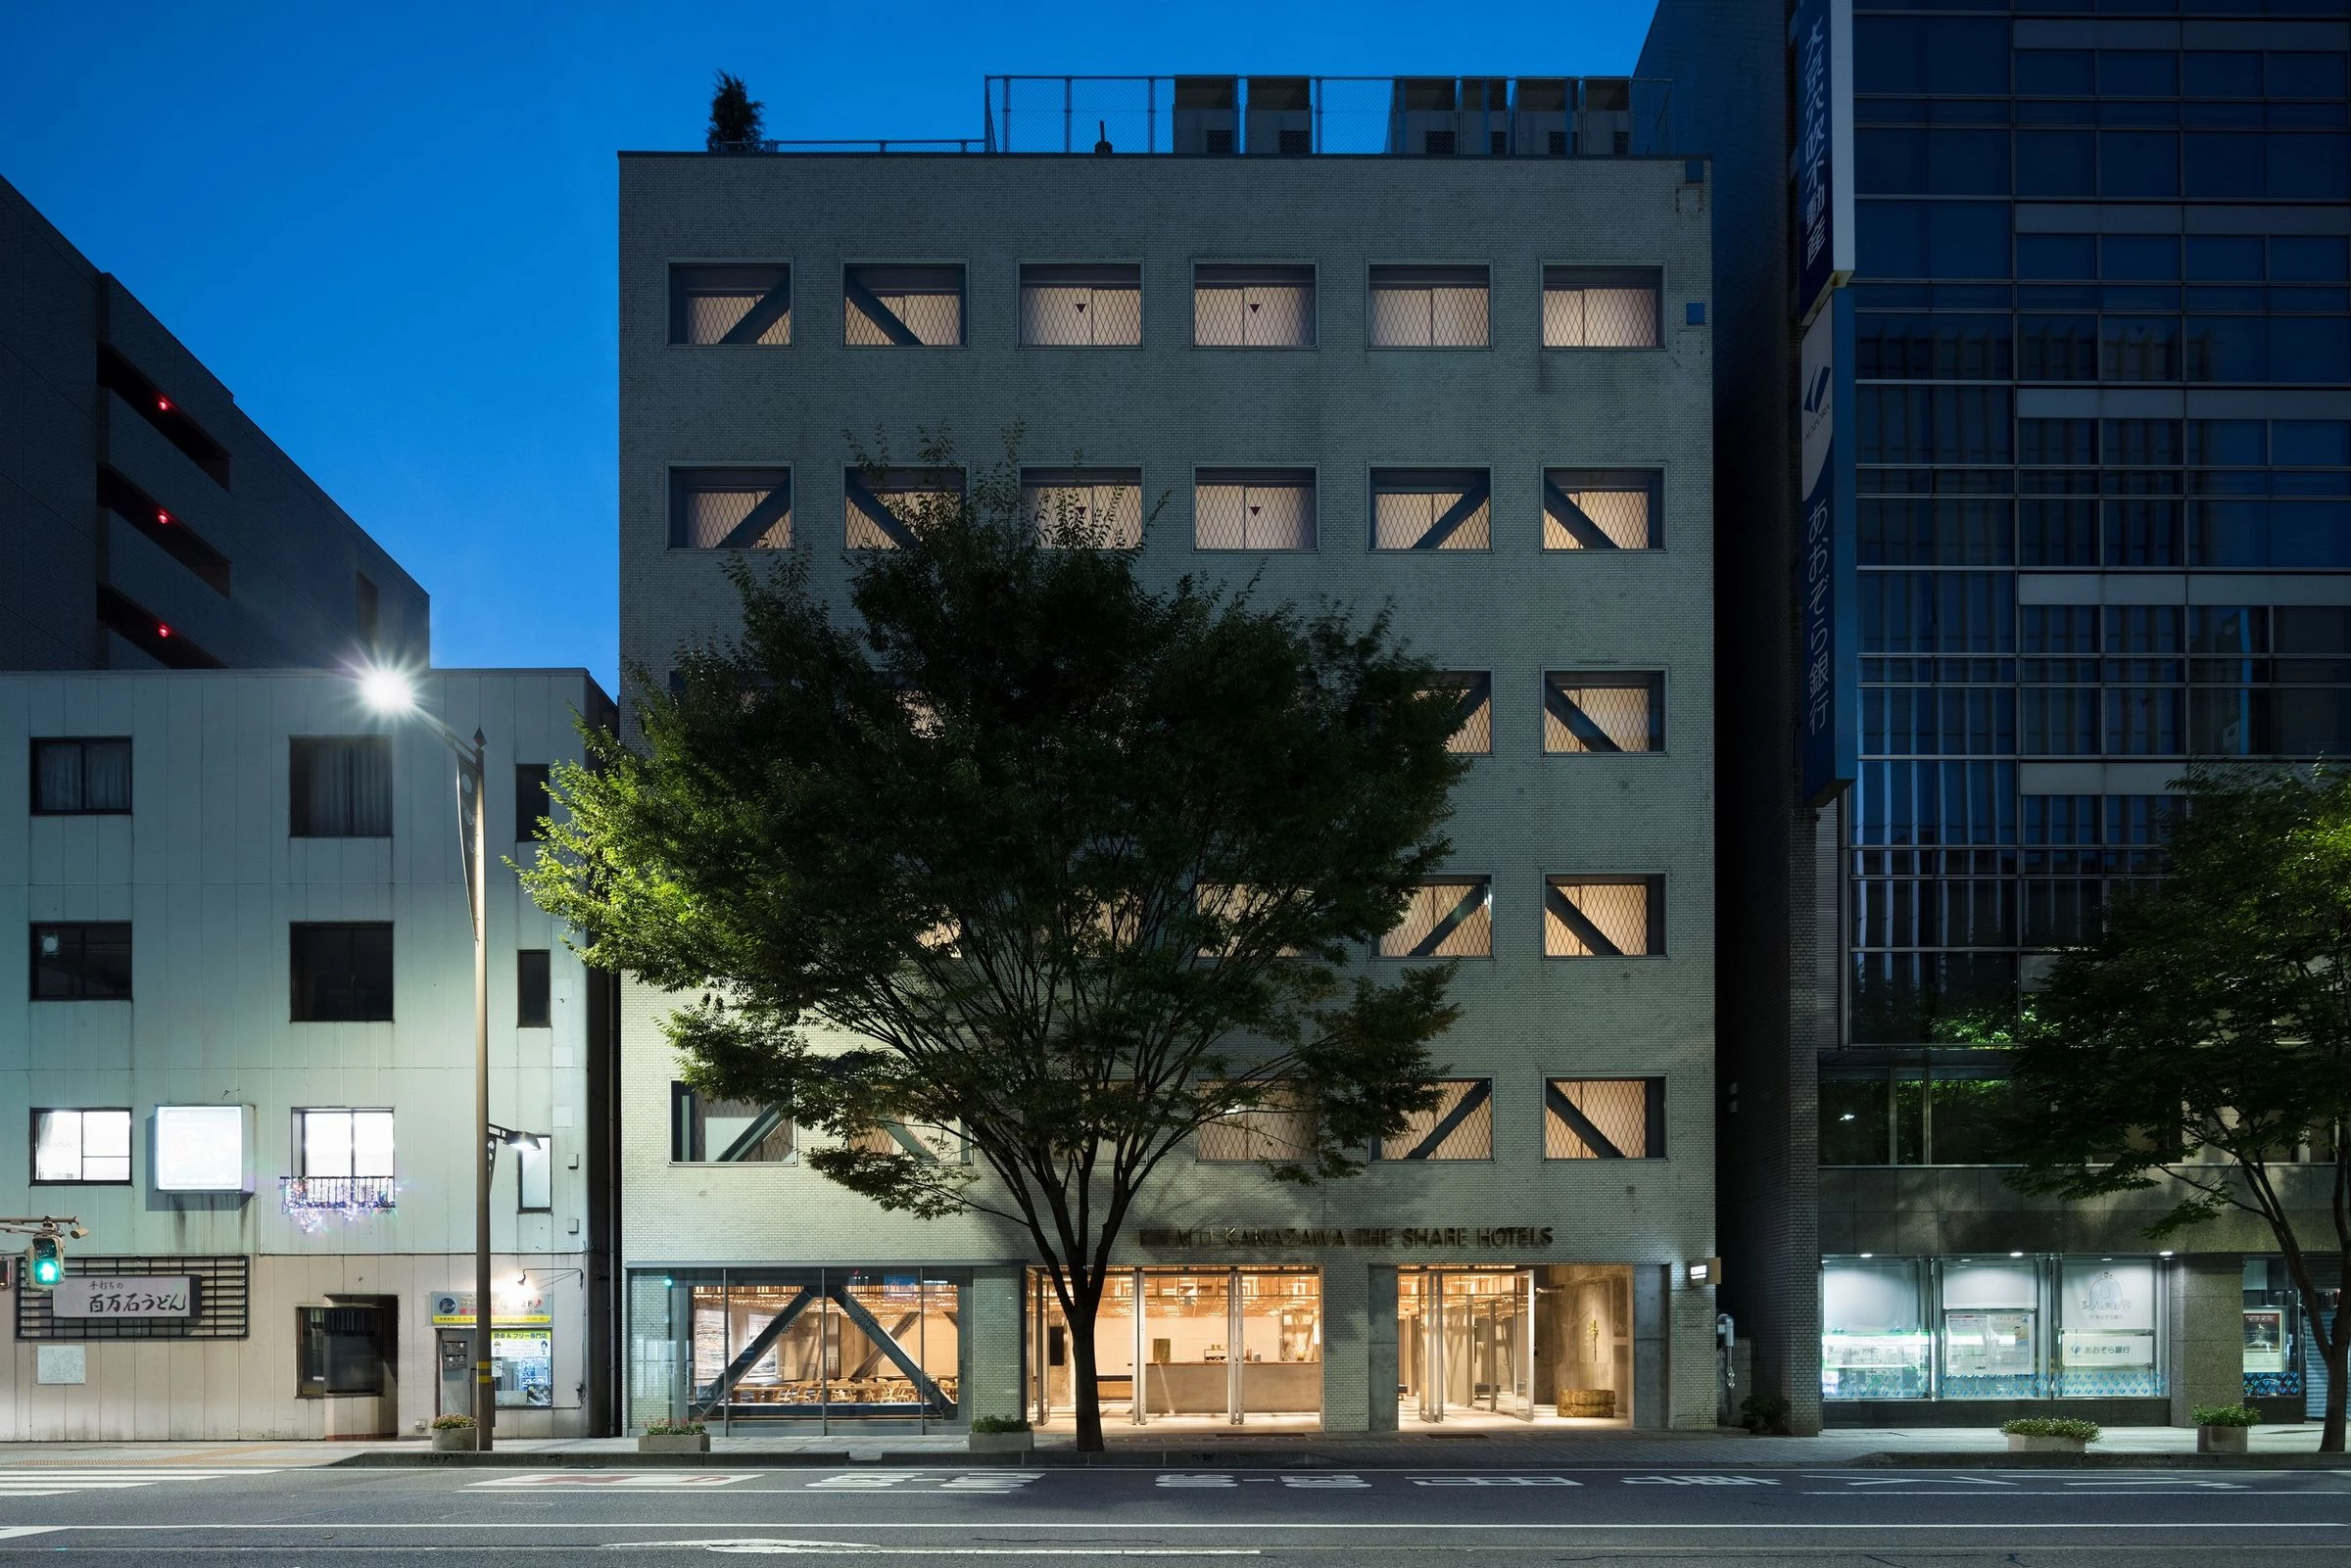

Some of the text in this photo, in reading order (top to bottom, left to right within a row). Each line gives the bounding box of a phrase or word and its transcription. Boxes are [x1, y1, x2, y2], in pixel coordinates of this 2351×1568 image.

[1804, 16, 1826, 270] 大京穴吹不動産
[1804, 404, 1831, 440] AOZORA
[1808, 499, 1829, 735] あおぞら銀行
[1224, 1226, 1347, 1247] KANAZAWA
[1355, 1227, 1391, 1247] THE
[1401, 1227, 1467, 1247] SHARE
[1477, 1226, 1555, 1247] HOTELS
[89, 1280, 123, 1290] 手打ちの
[89, 1293, 186, 1313] 百万石うどん
[2084, 1346, 2132, 1354] あおぞら銀行
